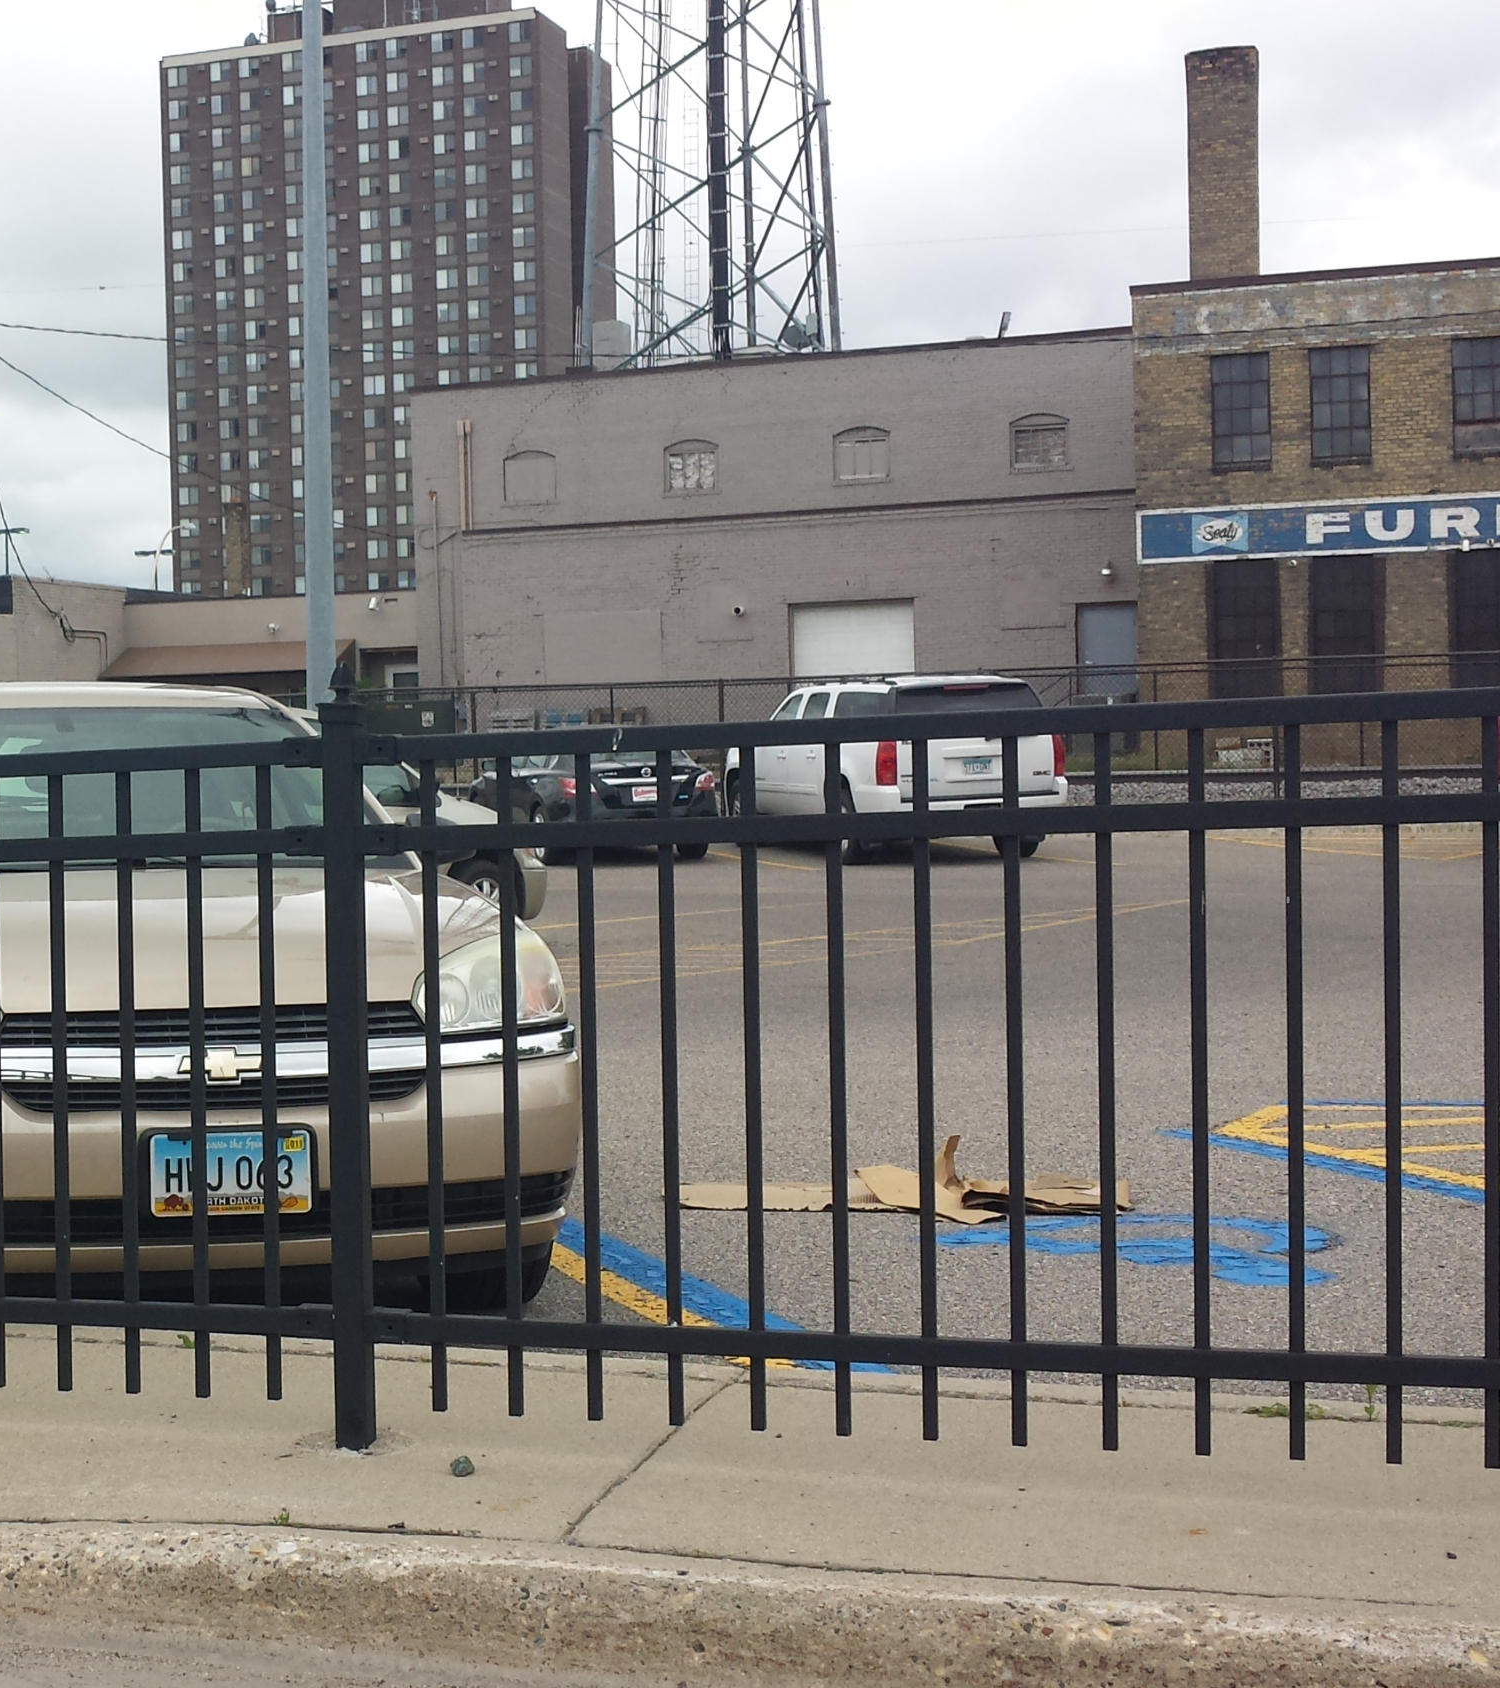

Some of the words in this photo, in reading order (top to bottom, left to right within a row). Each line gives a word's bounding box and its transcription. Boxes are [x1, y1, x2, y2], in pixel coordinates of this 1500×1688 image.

[1202, 521, 1238, 541] Sealy
[1305, 504, 1500, 544] FUR
[229, 1196, 265, 1205] DAKOT
